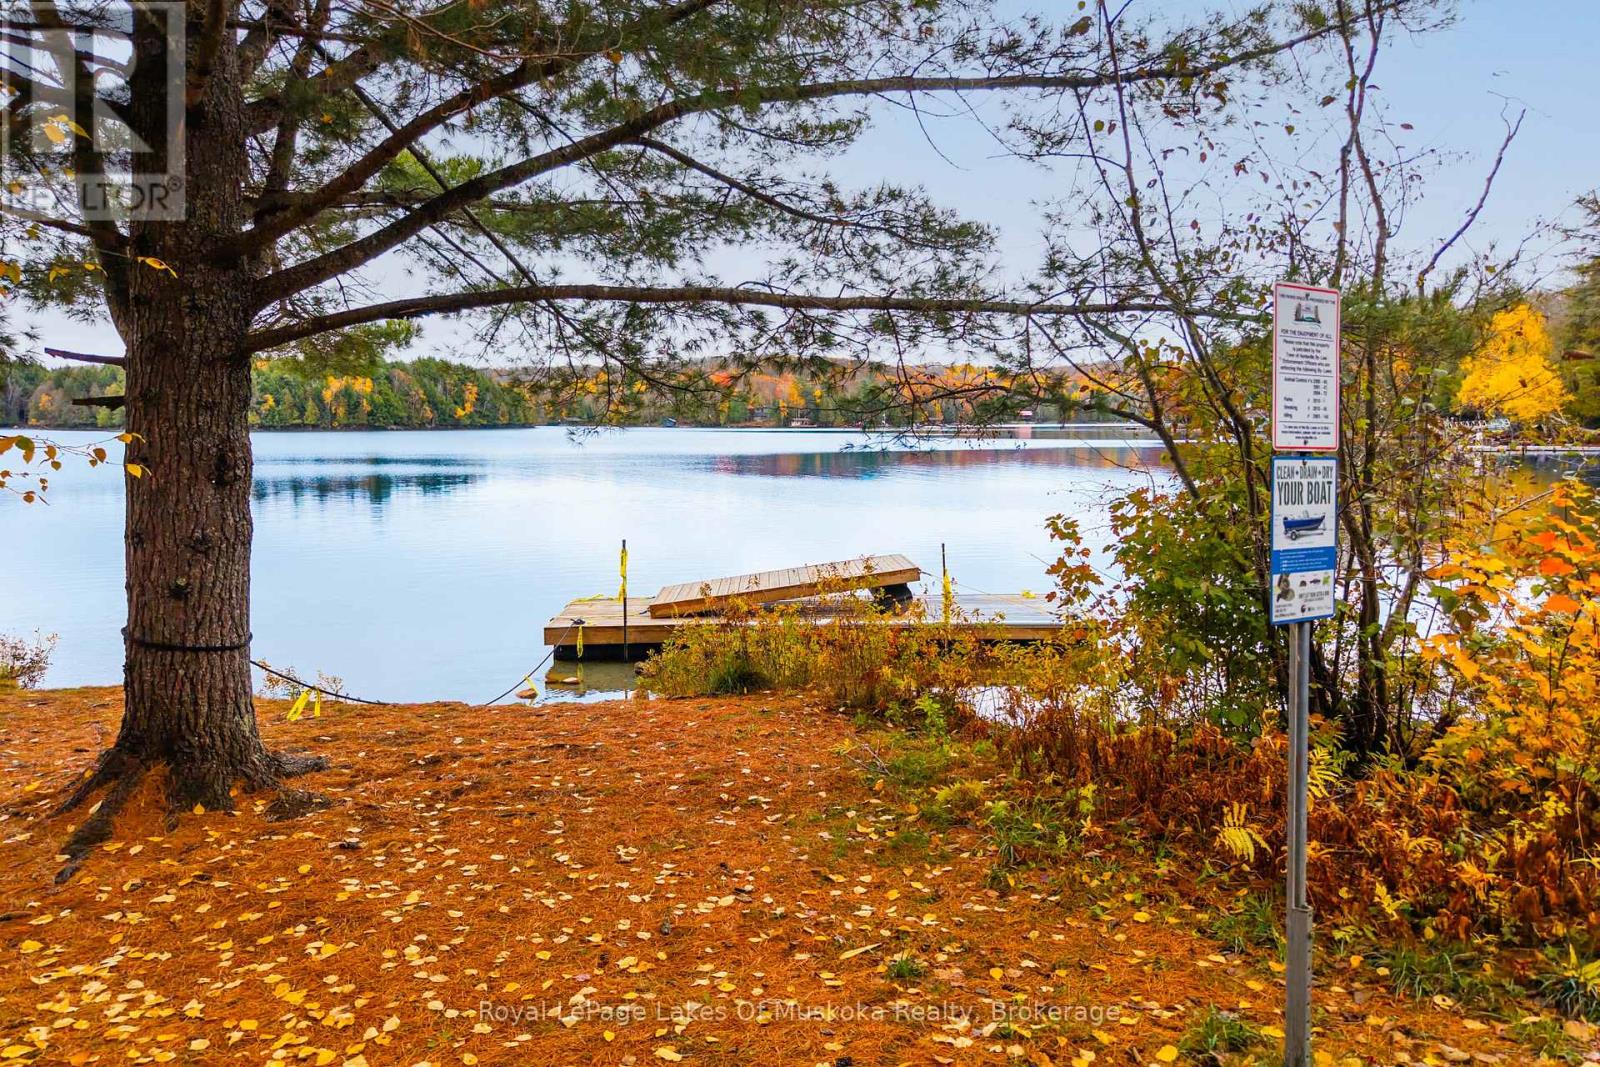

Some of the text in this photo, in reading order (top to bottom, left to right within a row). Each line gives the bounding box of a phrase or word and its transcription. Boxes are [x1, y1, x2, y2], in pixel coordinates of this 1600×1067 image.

[1277, 466, 1333, 479] CLEAN DRAIN DRY
[1277, 481, 1332, 505] YOUR BOAT
